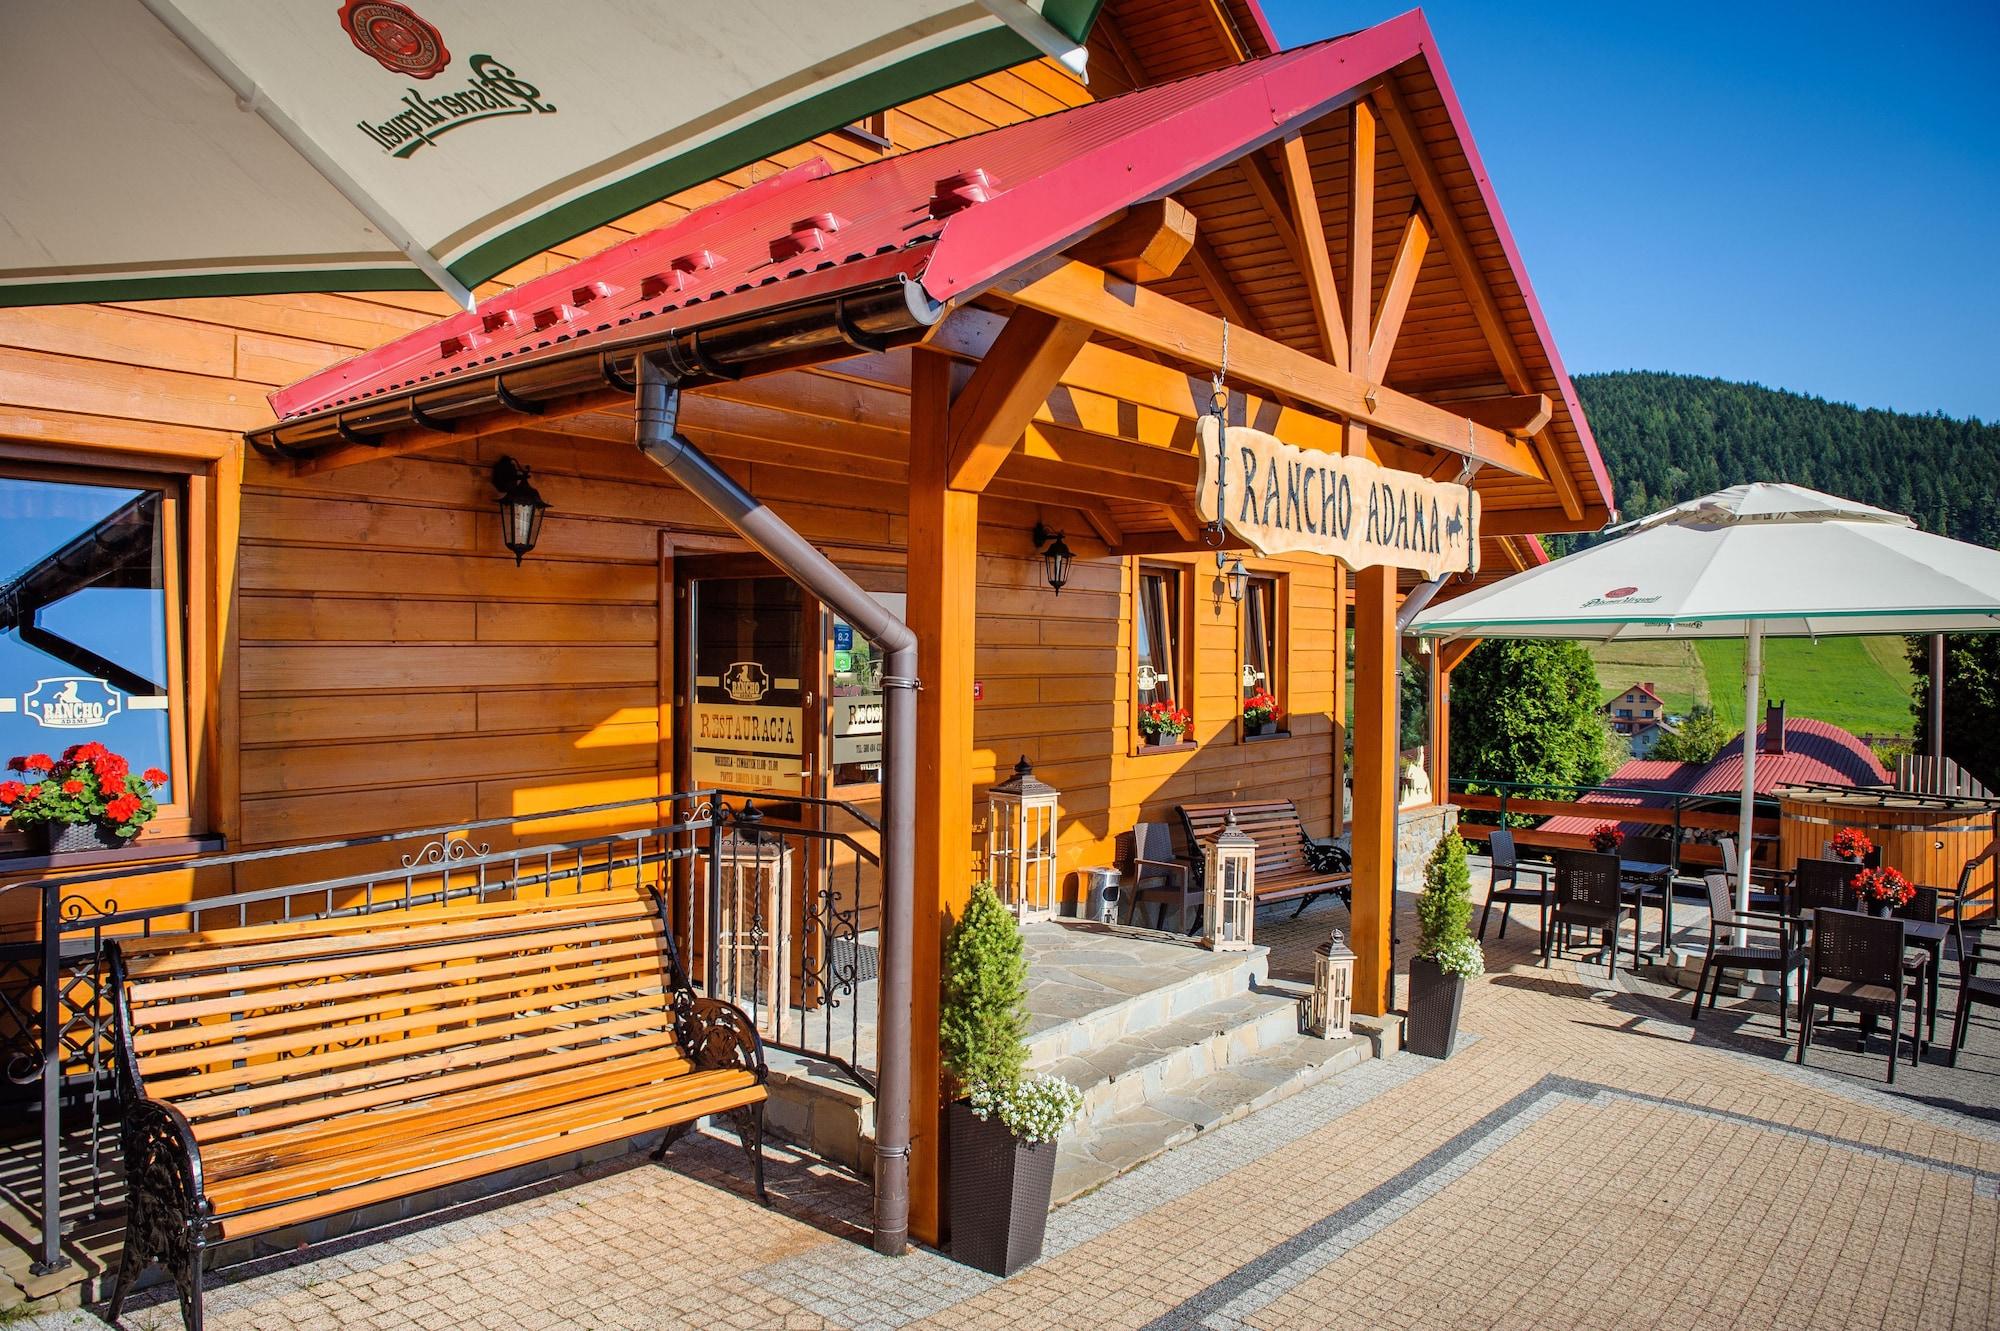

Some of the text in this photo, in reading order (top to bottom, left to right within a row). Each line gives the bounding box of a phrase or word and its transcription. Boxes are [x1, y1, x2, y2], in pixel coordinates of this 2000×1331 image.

[1240, 447, 1441, 554] RANCHO ADAMA
[838, 632, 849, 641] 8.2
[732, 681, 760, 695] RANCHO
[44, 702, 103, 719] RANCHO
[849, 704, 883, 725] RECE
[700, 713, 794, 743] RESTAURACJA
